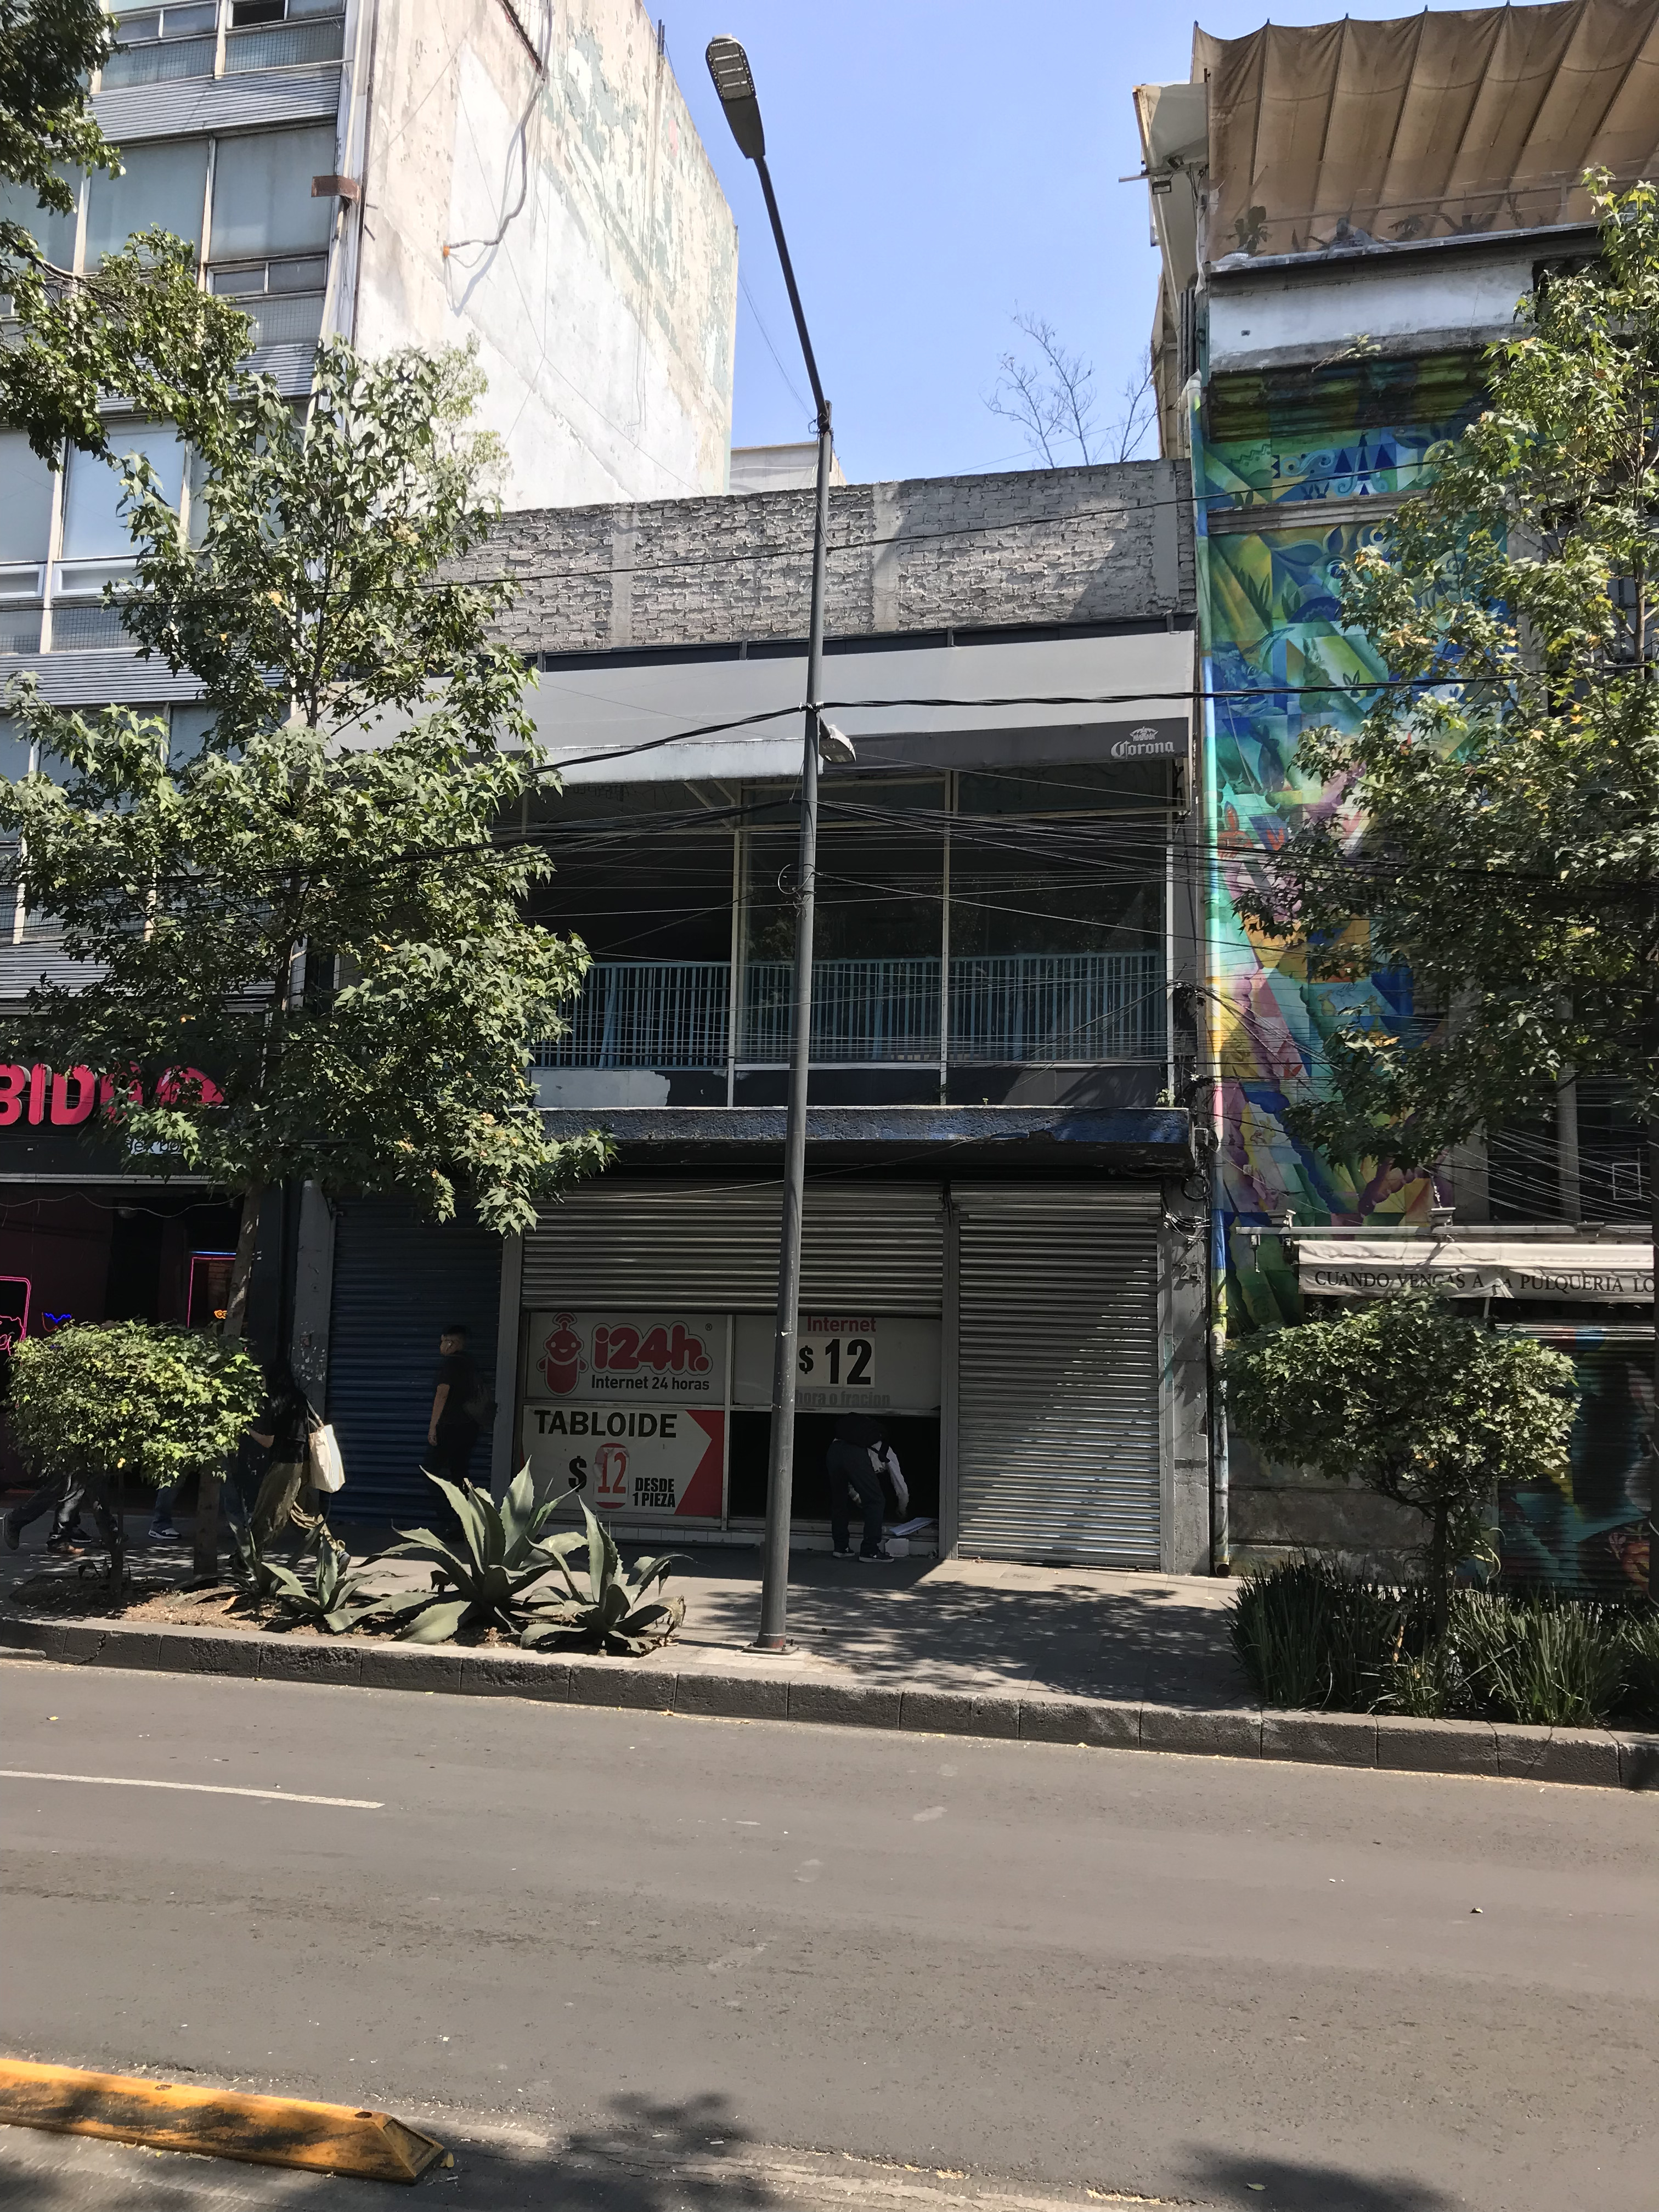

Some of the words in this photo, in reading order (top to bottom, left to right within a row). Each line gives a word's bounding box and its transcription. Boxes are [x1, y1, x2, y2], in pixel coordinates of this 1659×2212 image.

[1111, 741, 1175, 759] Corona
[1314, 1271, 1390, 1288] CUANDO
[1472, 1273, 1485, 1288] A
[1520, 1274, 1625, 1294] PULQUERIA
[807, 1316, 877, 1333] Internet
[825, 1339, 872, 1385] 12
[591, 1375, 648, 1390] Internet
[652, 1376, 668, 1390] 24
[672, 1377, 710, 1391] horas
[829, 1393, 838, 1406] o
[840, 1391, 891, 1407] fracion
[534, 1410, 678, 1438] TABLOIDE
[635, 1477, 675, 1493] DESDE
[633, 1492, 639, 1506] 1
[641, 1492, 676, 1508] PIEZA
